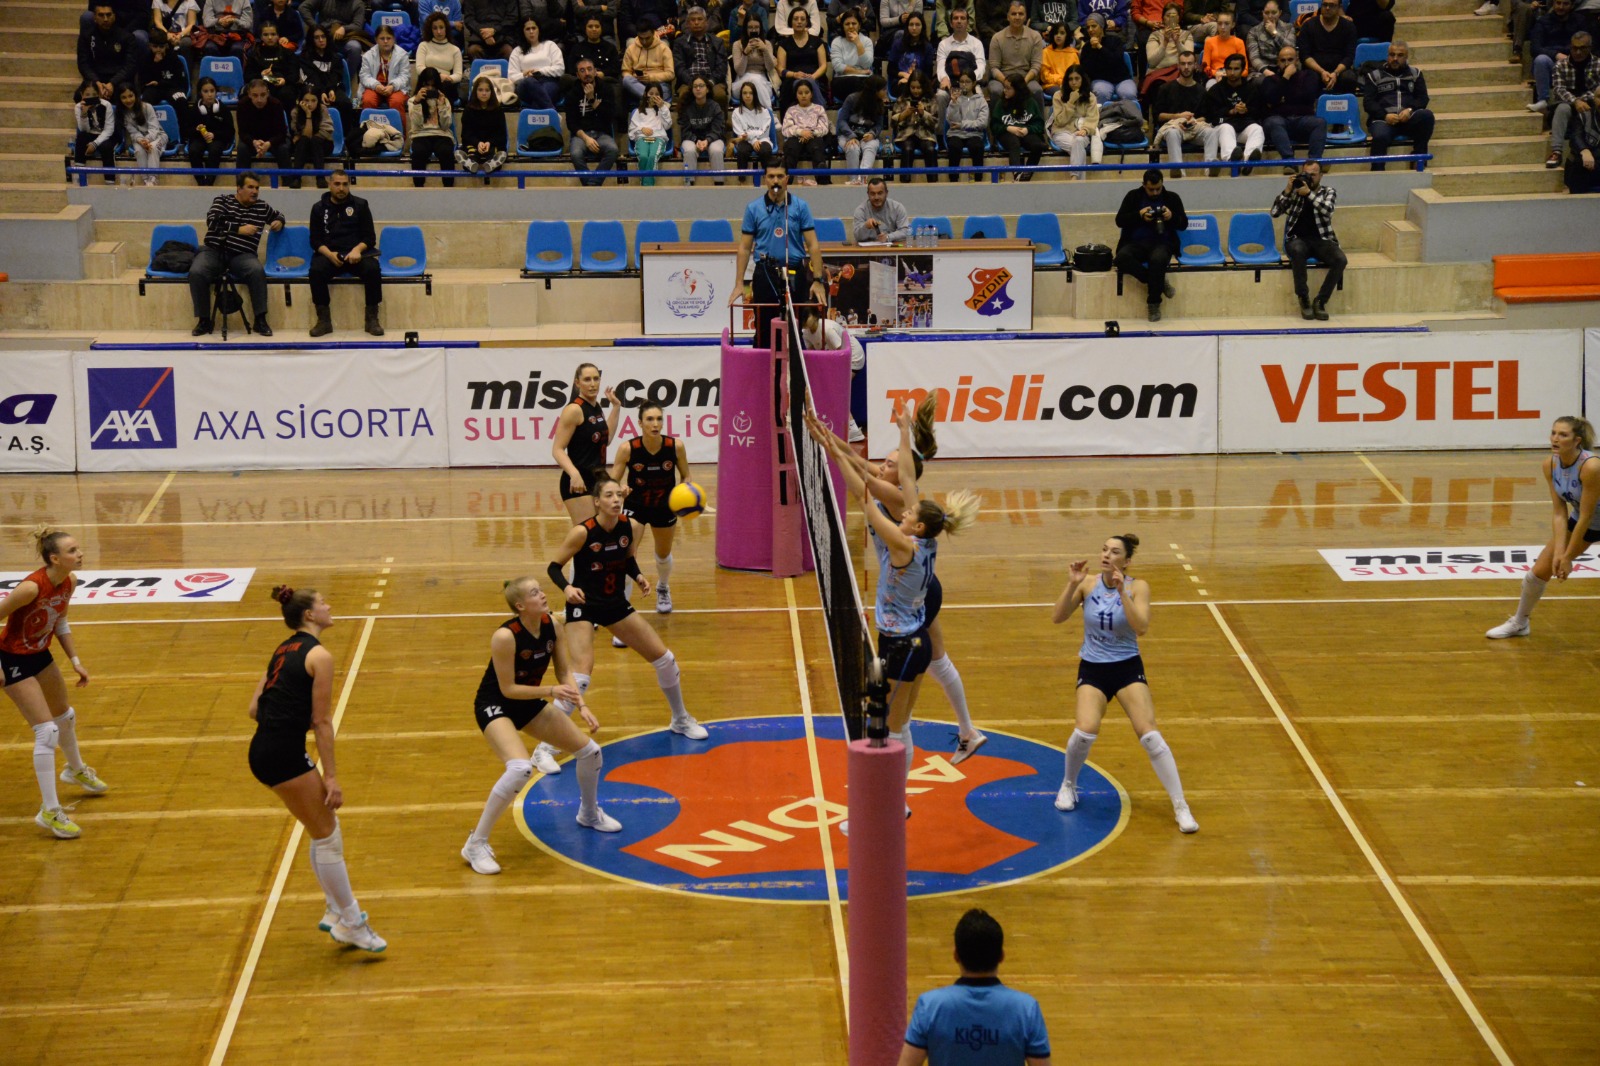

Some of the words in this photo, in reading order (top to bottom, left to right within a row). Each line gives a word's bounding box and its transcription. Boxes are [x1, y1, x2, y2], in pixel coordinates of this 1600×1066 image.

[214, 63, 231, 71] B-42
[531, 116, 546, 124] B-13
[971, 270, 1009, 310] AYDIN
[885, 374, 1199, 424] misli.com
[1261, 360, 1541, 423] VESTEL
[91, 410, 163, 442] AXA
[194, 410, 266, 440] AXA
[275, 403, 435, 440] SİGORTA
[8, 435, 50, 455] A.Ş.
[728, 434, 756, 448] TVF
[1098, 610, 1114, 631] 11
[483, 705, 504, 718] 12
[654, 754, 967, 868] ADIN
